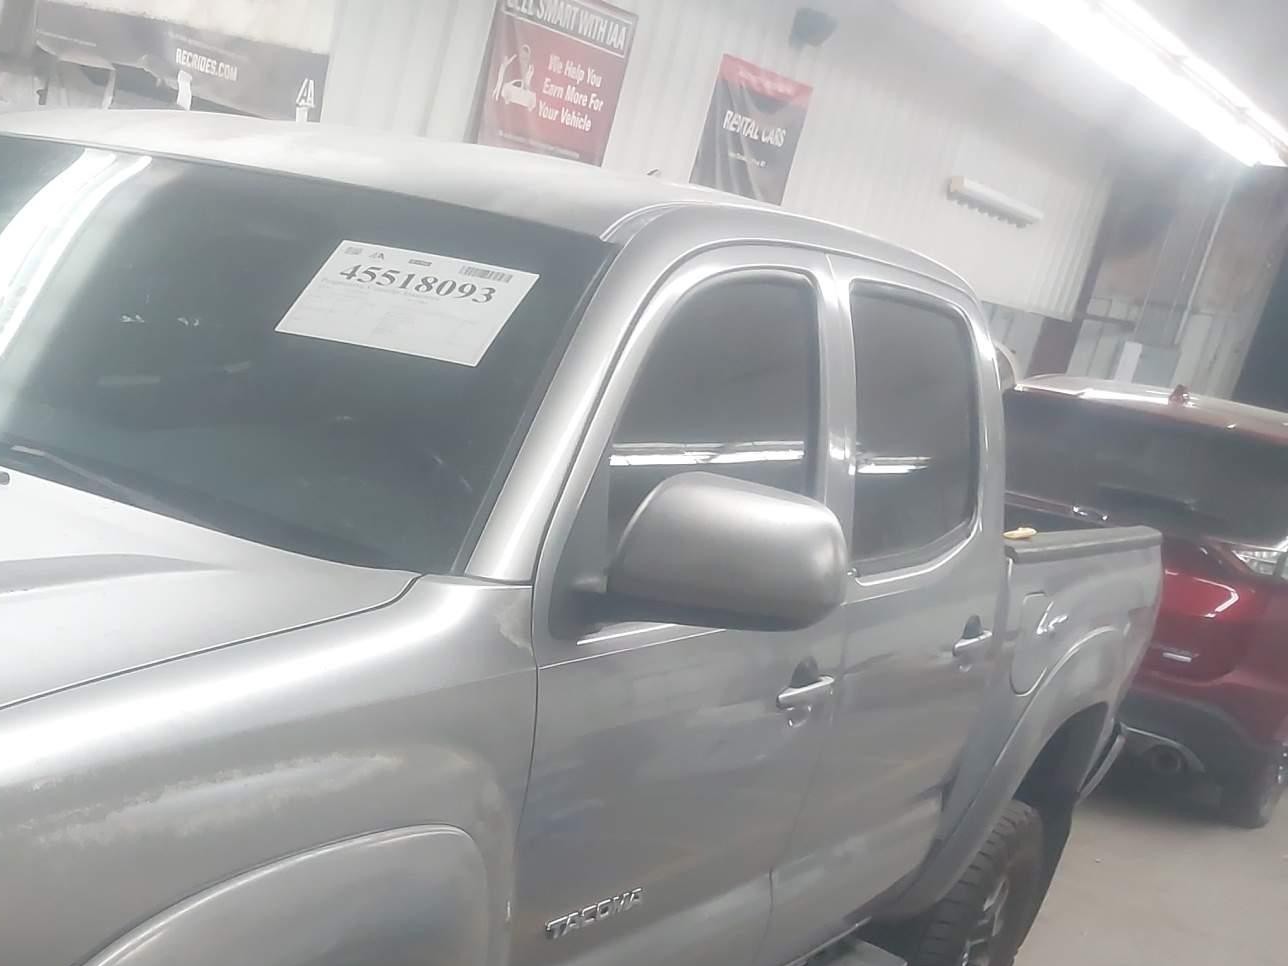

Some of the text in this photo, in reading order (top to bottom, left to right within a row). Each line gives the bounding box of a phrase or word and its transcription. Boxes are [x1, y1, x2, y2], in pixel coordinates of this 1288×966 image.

[536, 0, 580, 32] SMART
[577, 10, 608, 43] WITH
[606, 21, 627, 50] IAA
[175, 47, 238, 81] RECRIDES.COM
[548, 54, 603, 88] We Help You
[542, 77, 604, 112] Earn More For
[538, 100, 592, 132] Your Vehicle
[761, 127, 787, 148] CARS
[339, 264, 497, 304] 45518093
[544, 887, 643, 939] TACOMA
